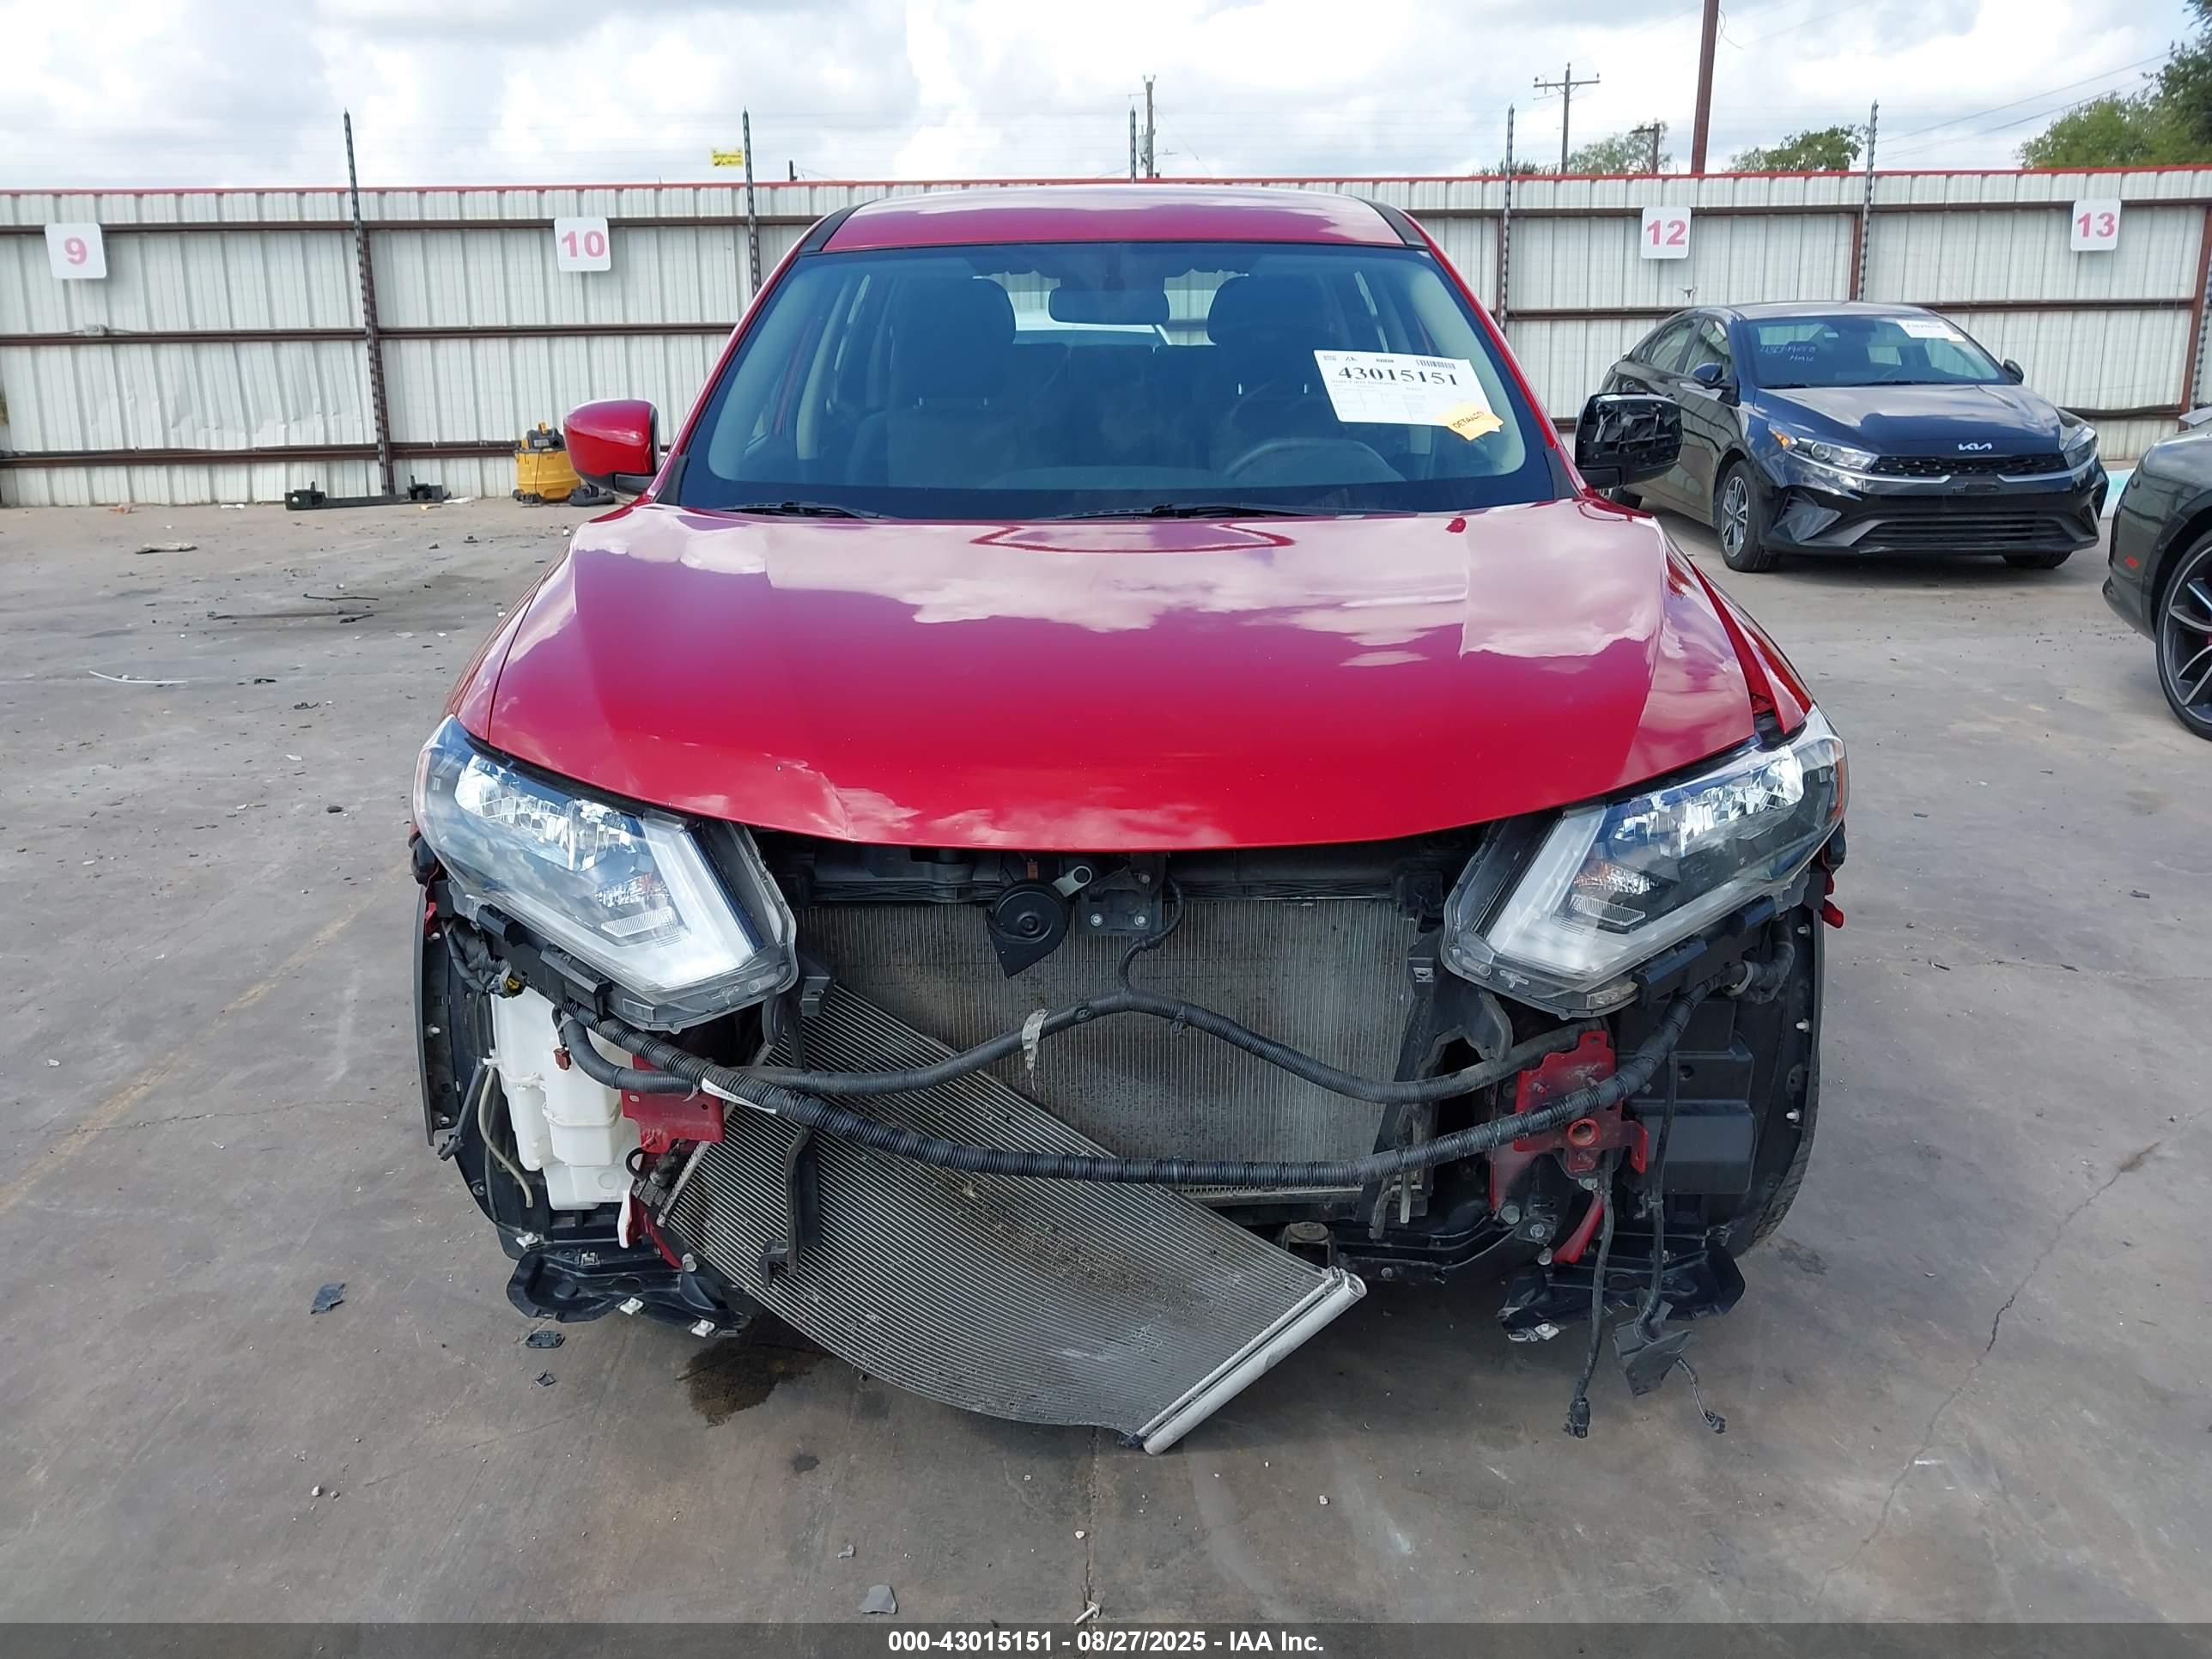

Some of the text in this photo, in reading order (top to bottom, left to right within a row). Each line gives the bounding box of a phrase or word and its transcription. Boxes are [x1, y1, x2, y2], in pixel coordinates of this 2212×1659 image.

[1648, 220, 1687, 246] 12
[2078, 213, 2116, 239] 13
[65, 240, 88, 264] 9
[563, 231, 606, 258] 10
[1338, 367, 1458, 386] 43015151
